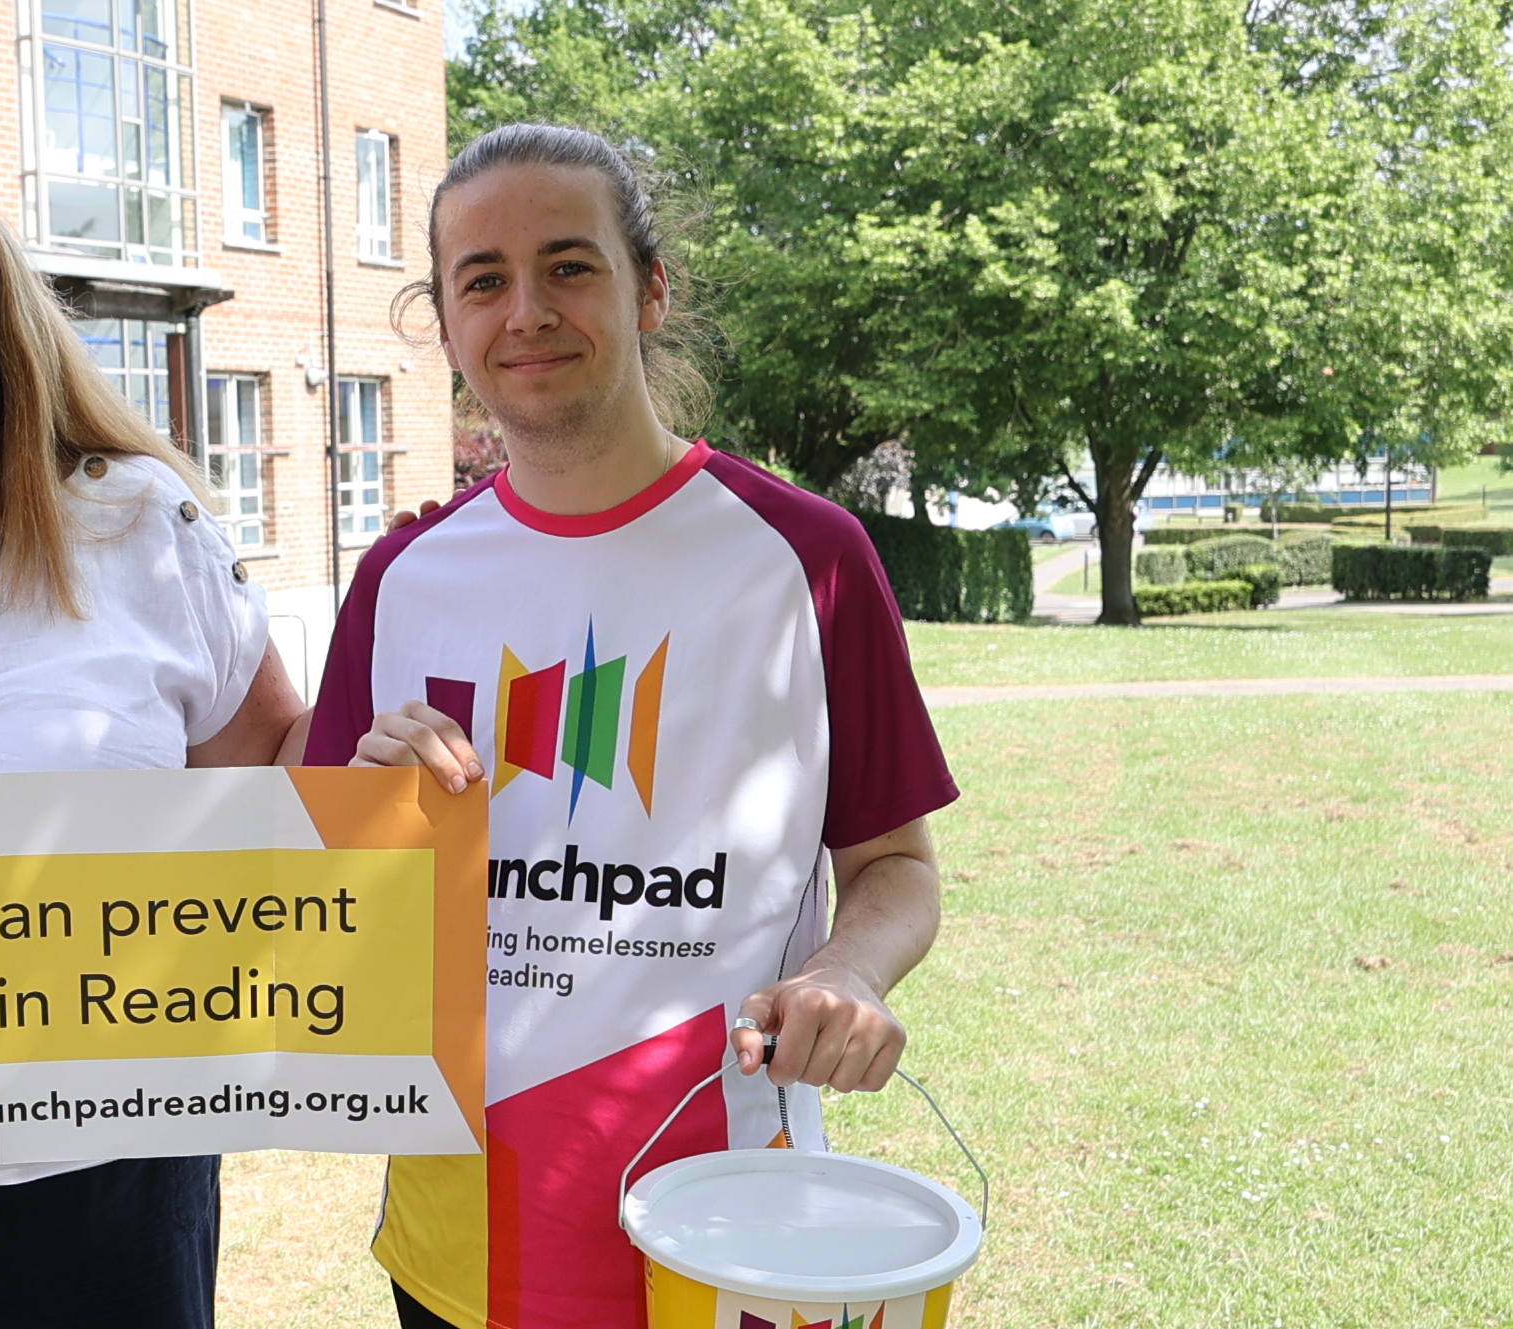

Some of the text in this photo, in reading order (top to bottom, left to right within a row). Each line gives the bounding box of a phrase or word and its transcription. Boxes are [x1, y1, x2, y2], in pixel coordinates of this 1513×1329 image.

[101, 888, 357, 955] prevent
[526, 925, 717, 958] homelessness
[80, 965, 344, 1036] Reading
[486, 962, 574, 997] eading
